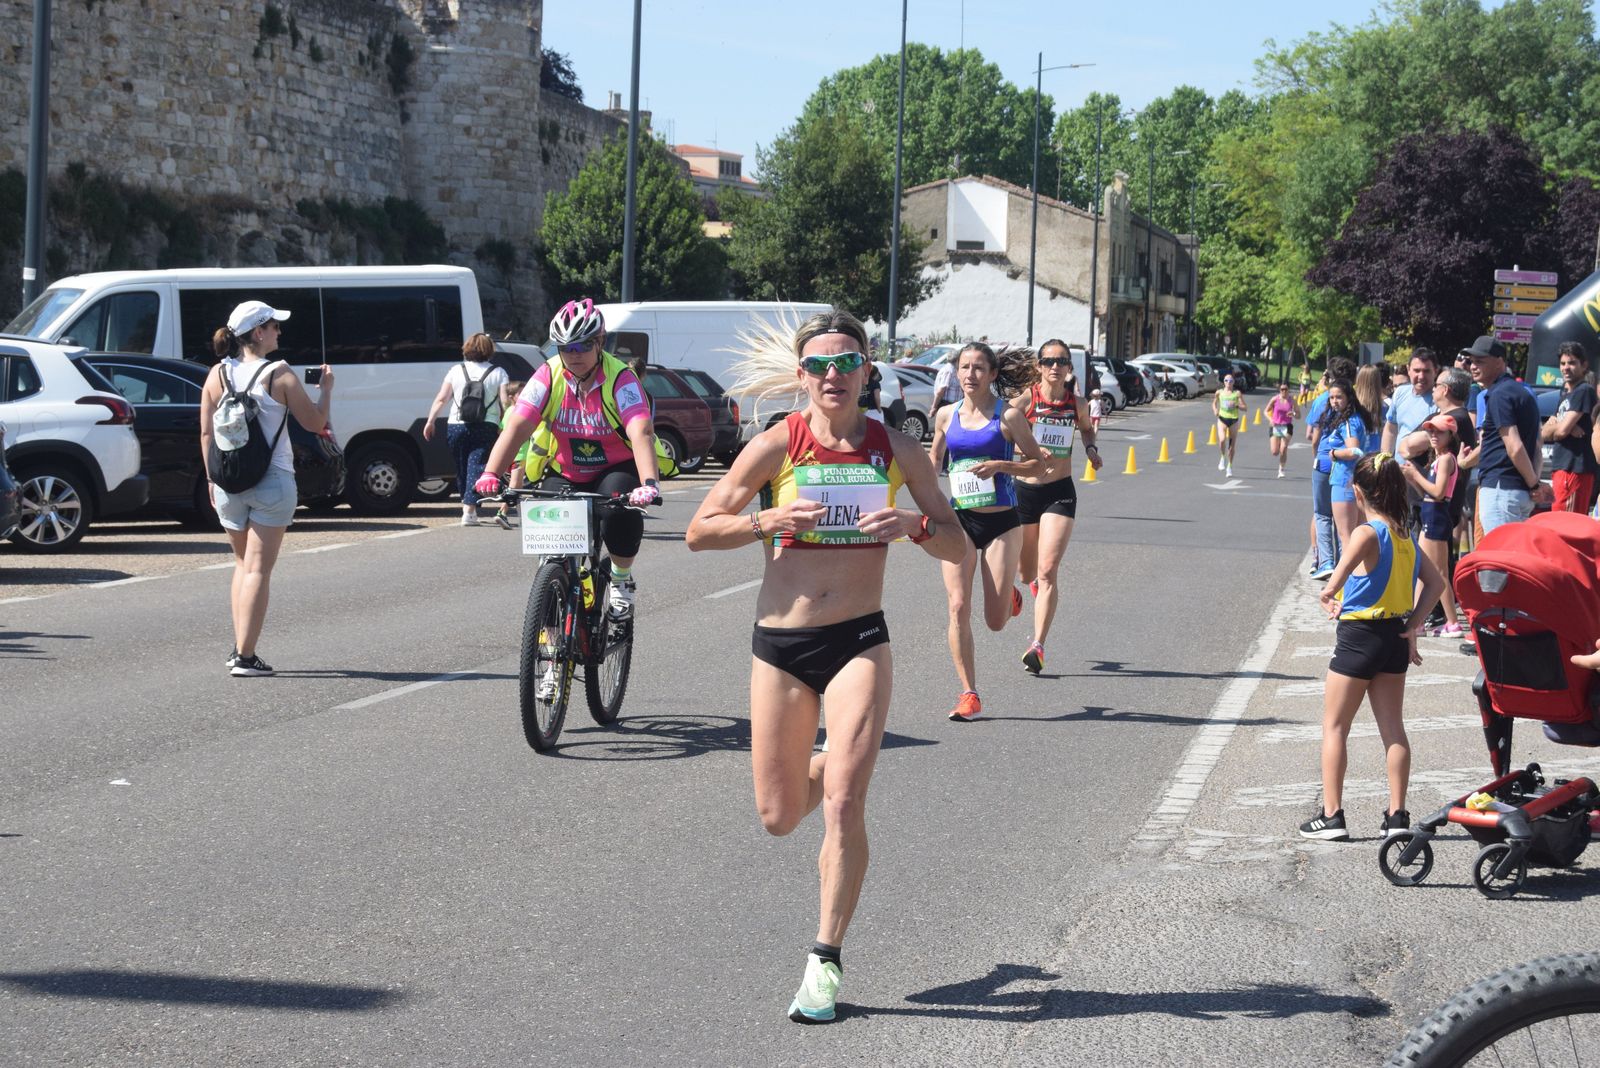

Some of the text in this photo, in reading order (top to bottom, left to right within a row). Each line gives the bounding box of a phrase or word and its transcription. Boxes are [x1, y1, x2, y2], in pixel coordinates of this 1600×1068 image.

[1041, 433, 1065, 446] MARTA
[823, 476, 846, 484] CAJA
[847, 475, 878, 483] RURAL
[821, 491, 829, 503] 11
[524, 532, 586, 542] ORGANIZACIÓN
[822, 536, 847, 544] CAJA
